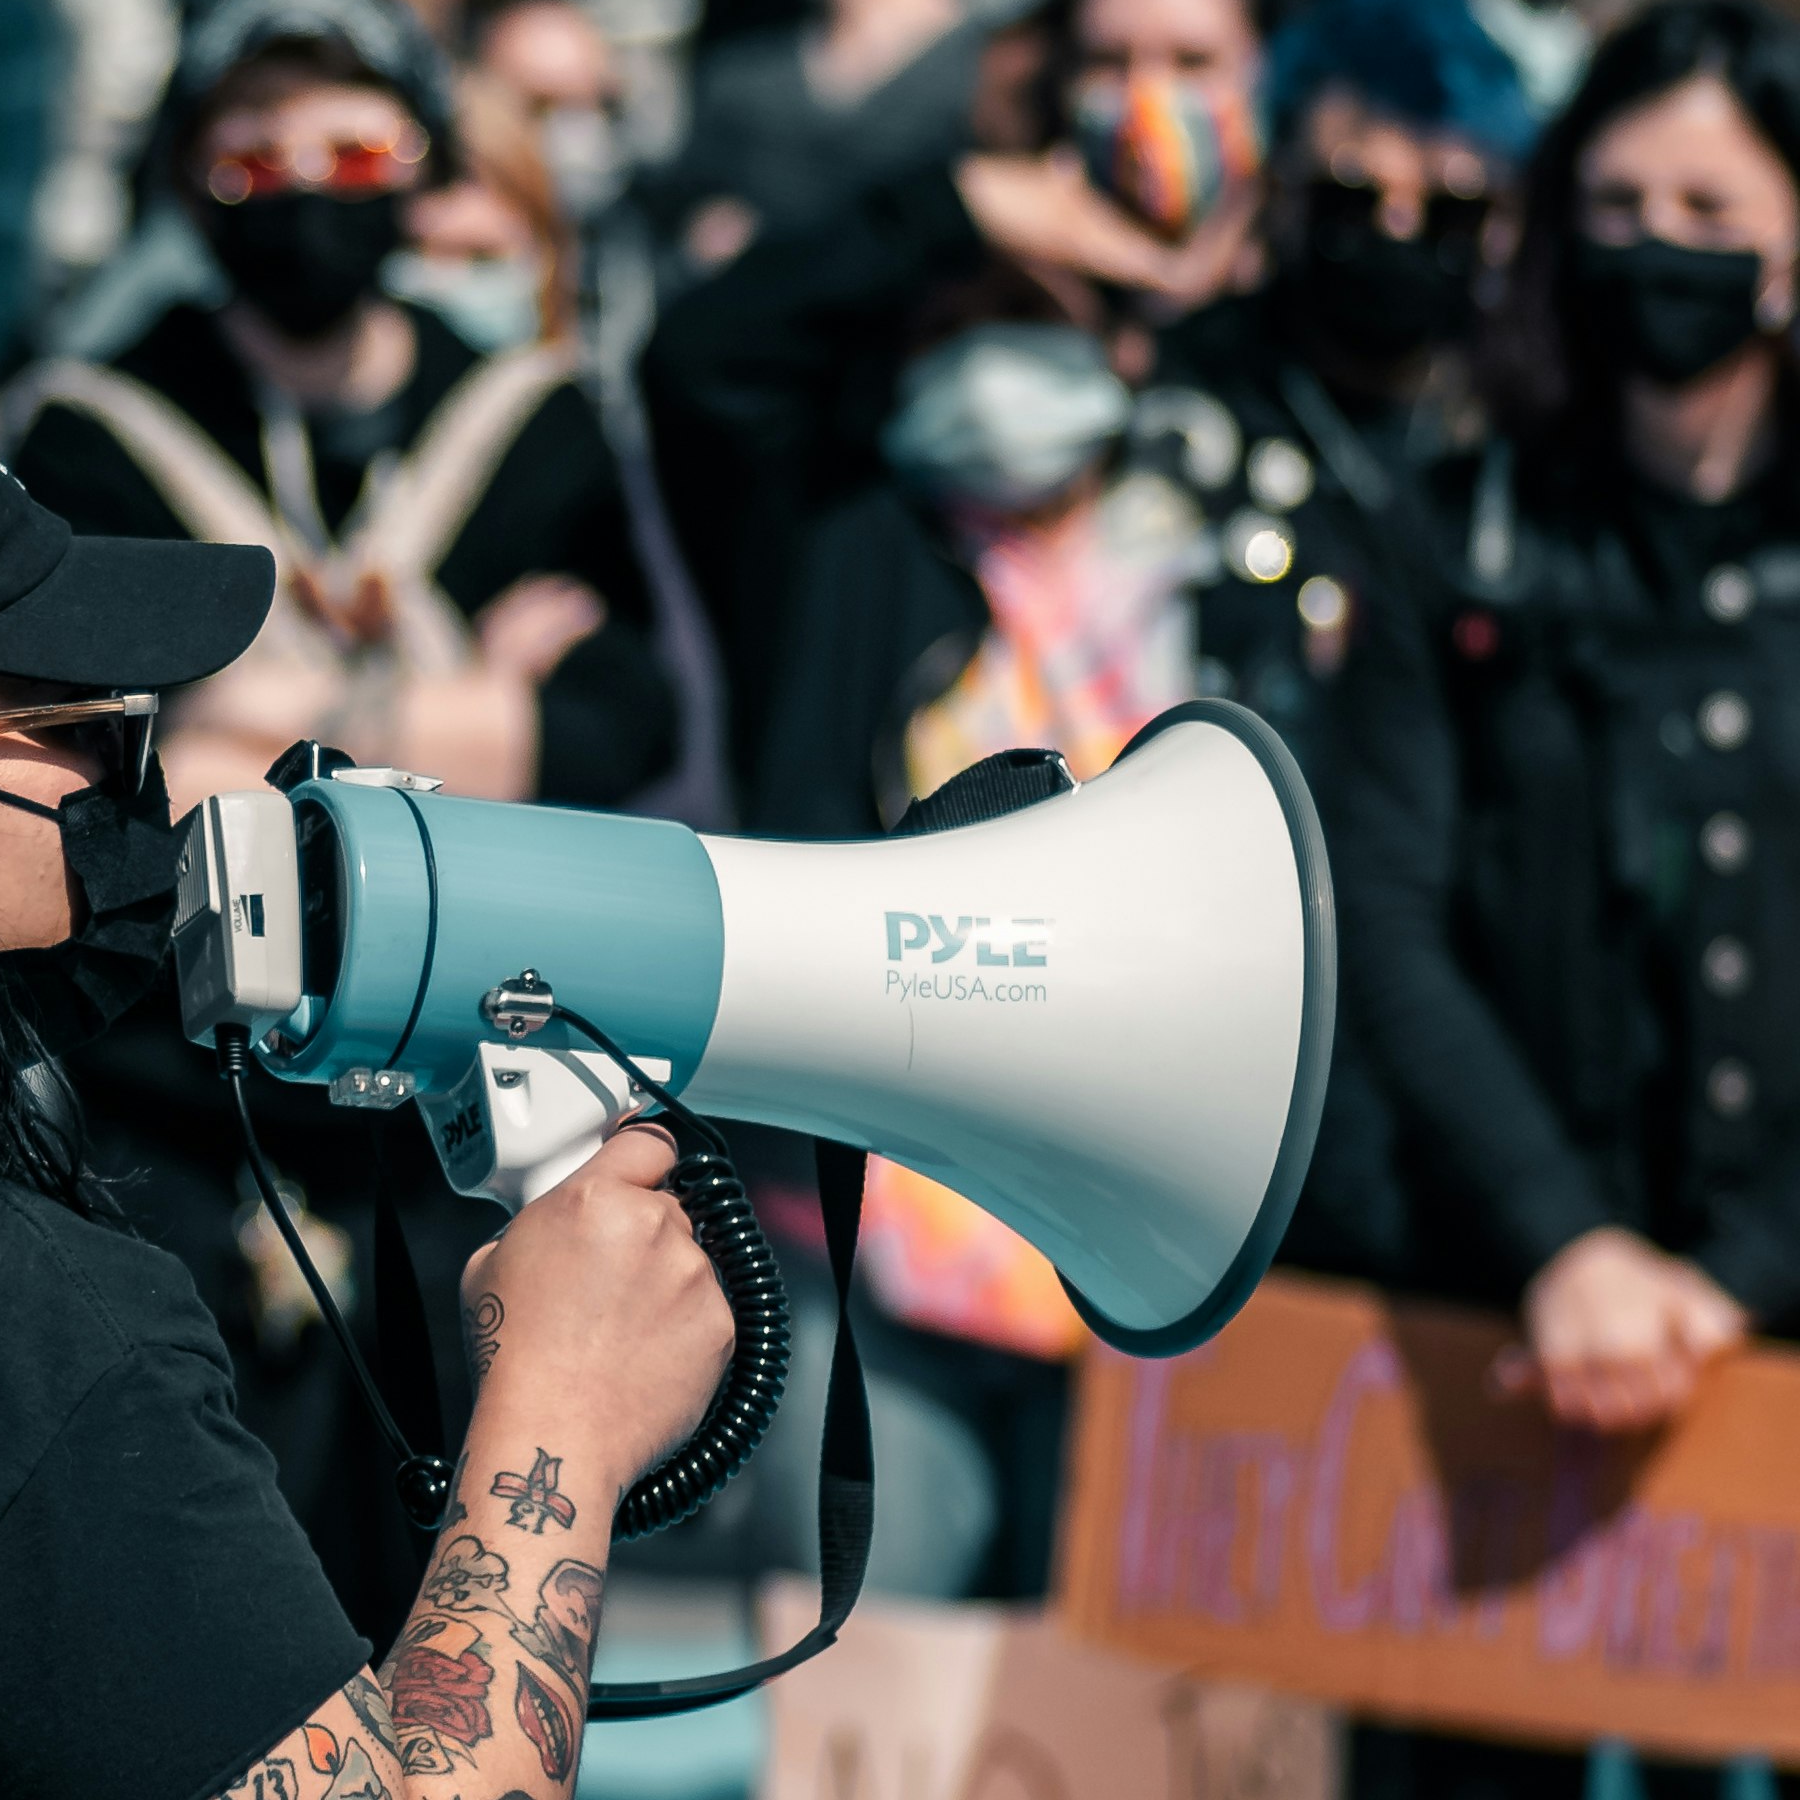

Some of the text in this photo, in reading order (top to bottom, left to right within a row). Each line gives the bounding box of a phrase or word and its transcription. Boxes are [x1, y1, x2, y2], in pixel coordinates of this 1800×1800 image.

[231, 898, 243, 934] VOLUME
[884, 910, 1048, 967] PYLE
[885, 969, 1047, 1002] PyleUSA.com
[441, 1100, 484, 1154] PYLE
